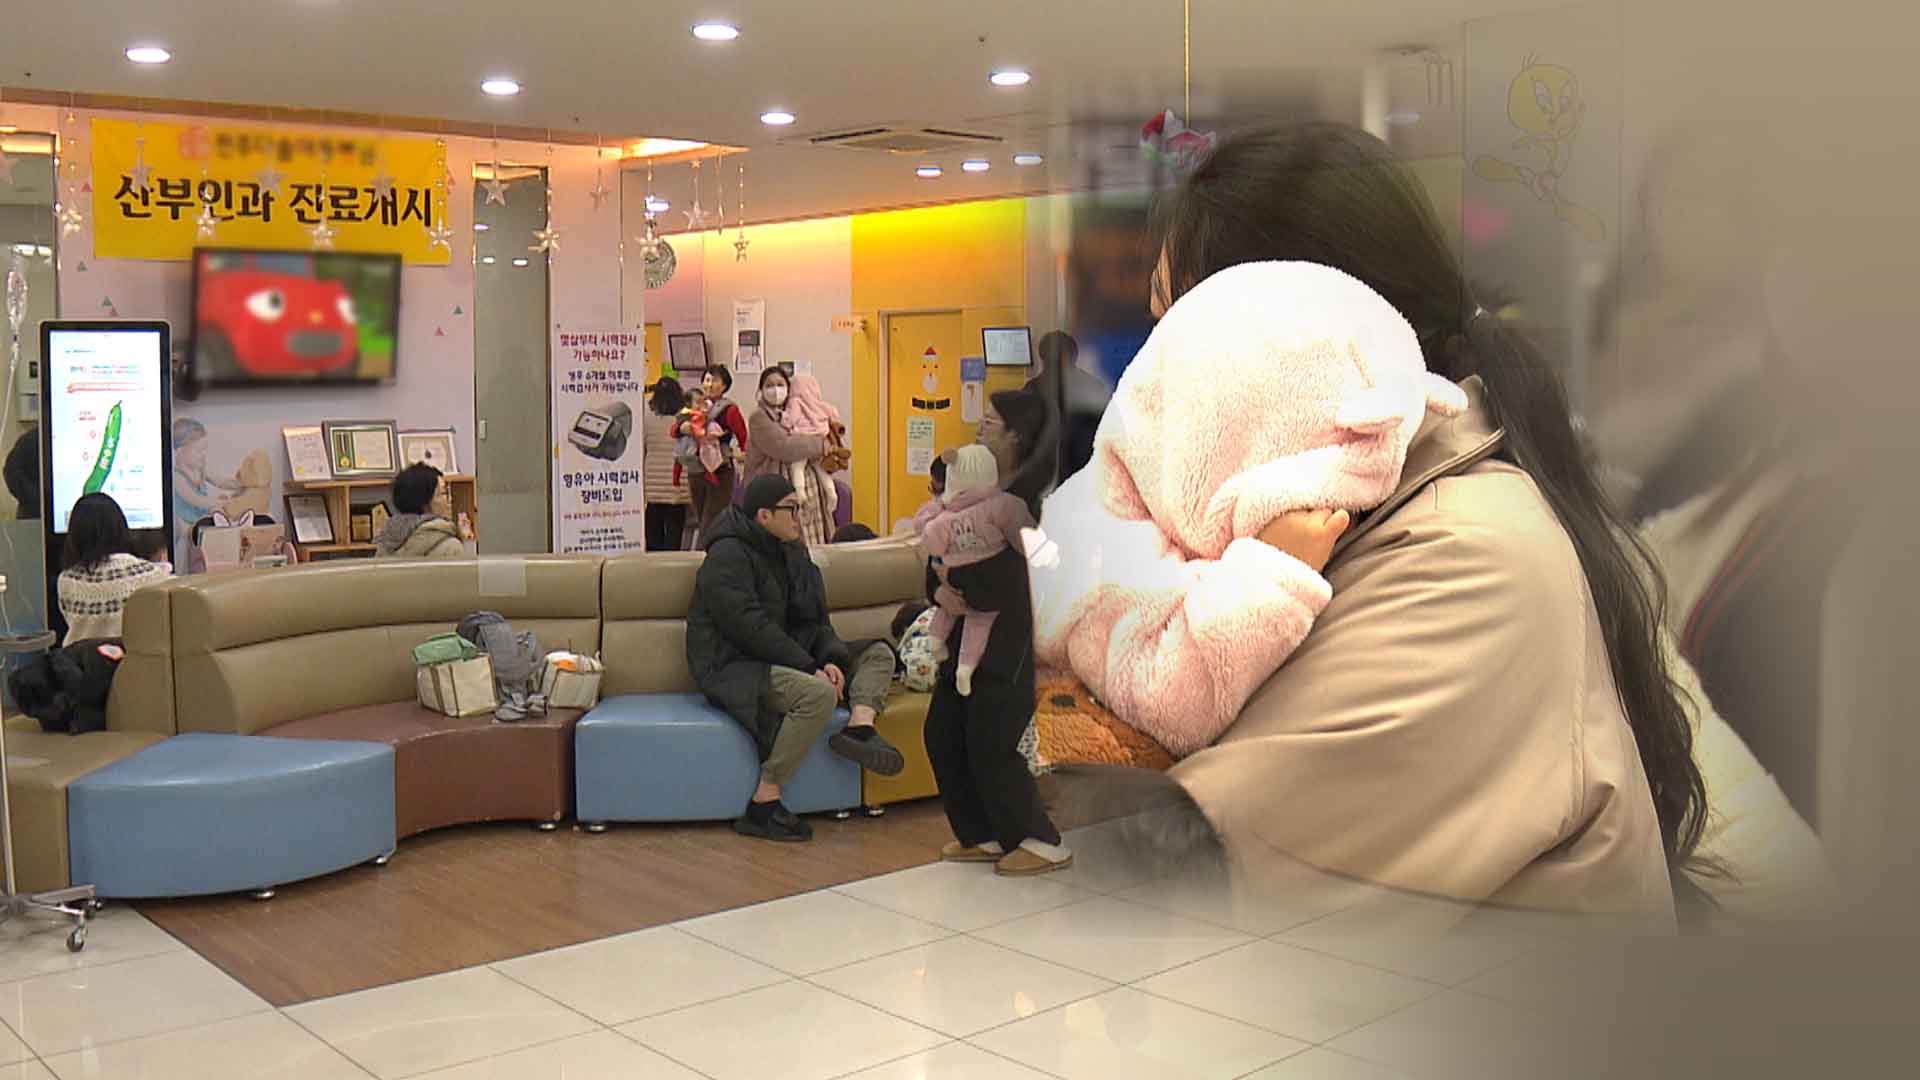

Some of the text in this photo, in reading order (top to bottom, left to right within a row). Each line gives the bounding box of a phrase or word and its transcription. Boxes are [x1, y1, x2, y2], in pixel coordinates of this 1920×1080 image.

[114, 174, 433, 227] 산부인과 진료개시
[602, 334, 637, 346] 시력검사
[574, 350, 625, 362] 가능하나요?
[563, 470, 639, 488] 영유아 시력검사
[581, 488, 623, 504] 장비도입
